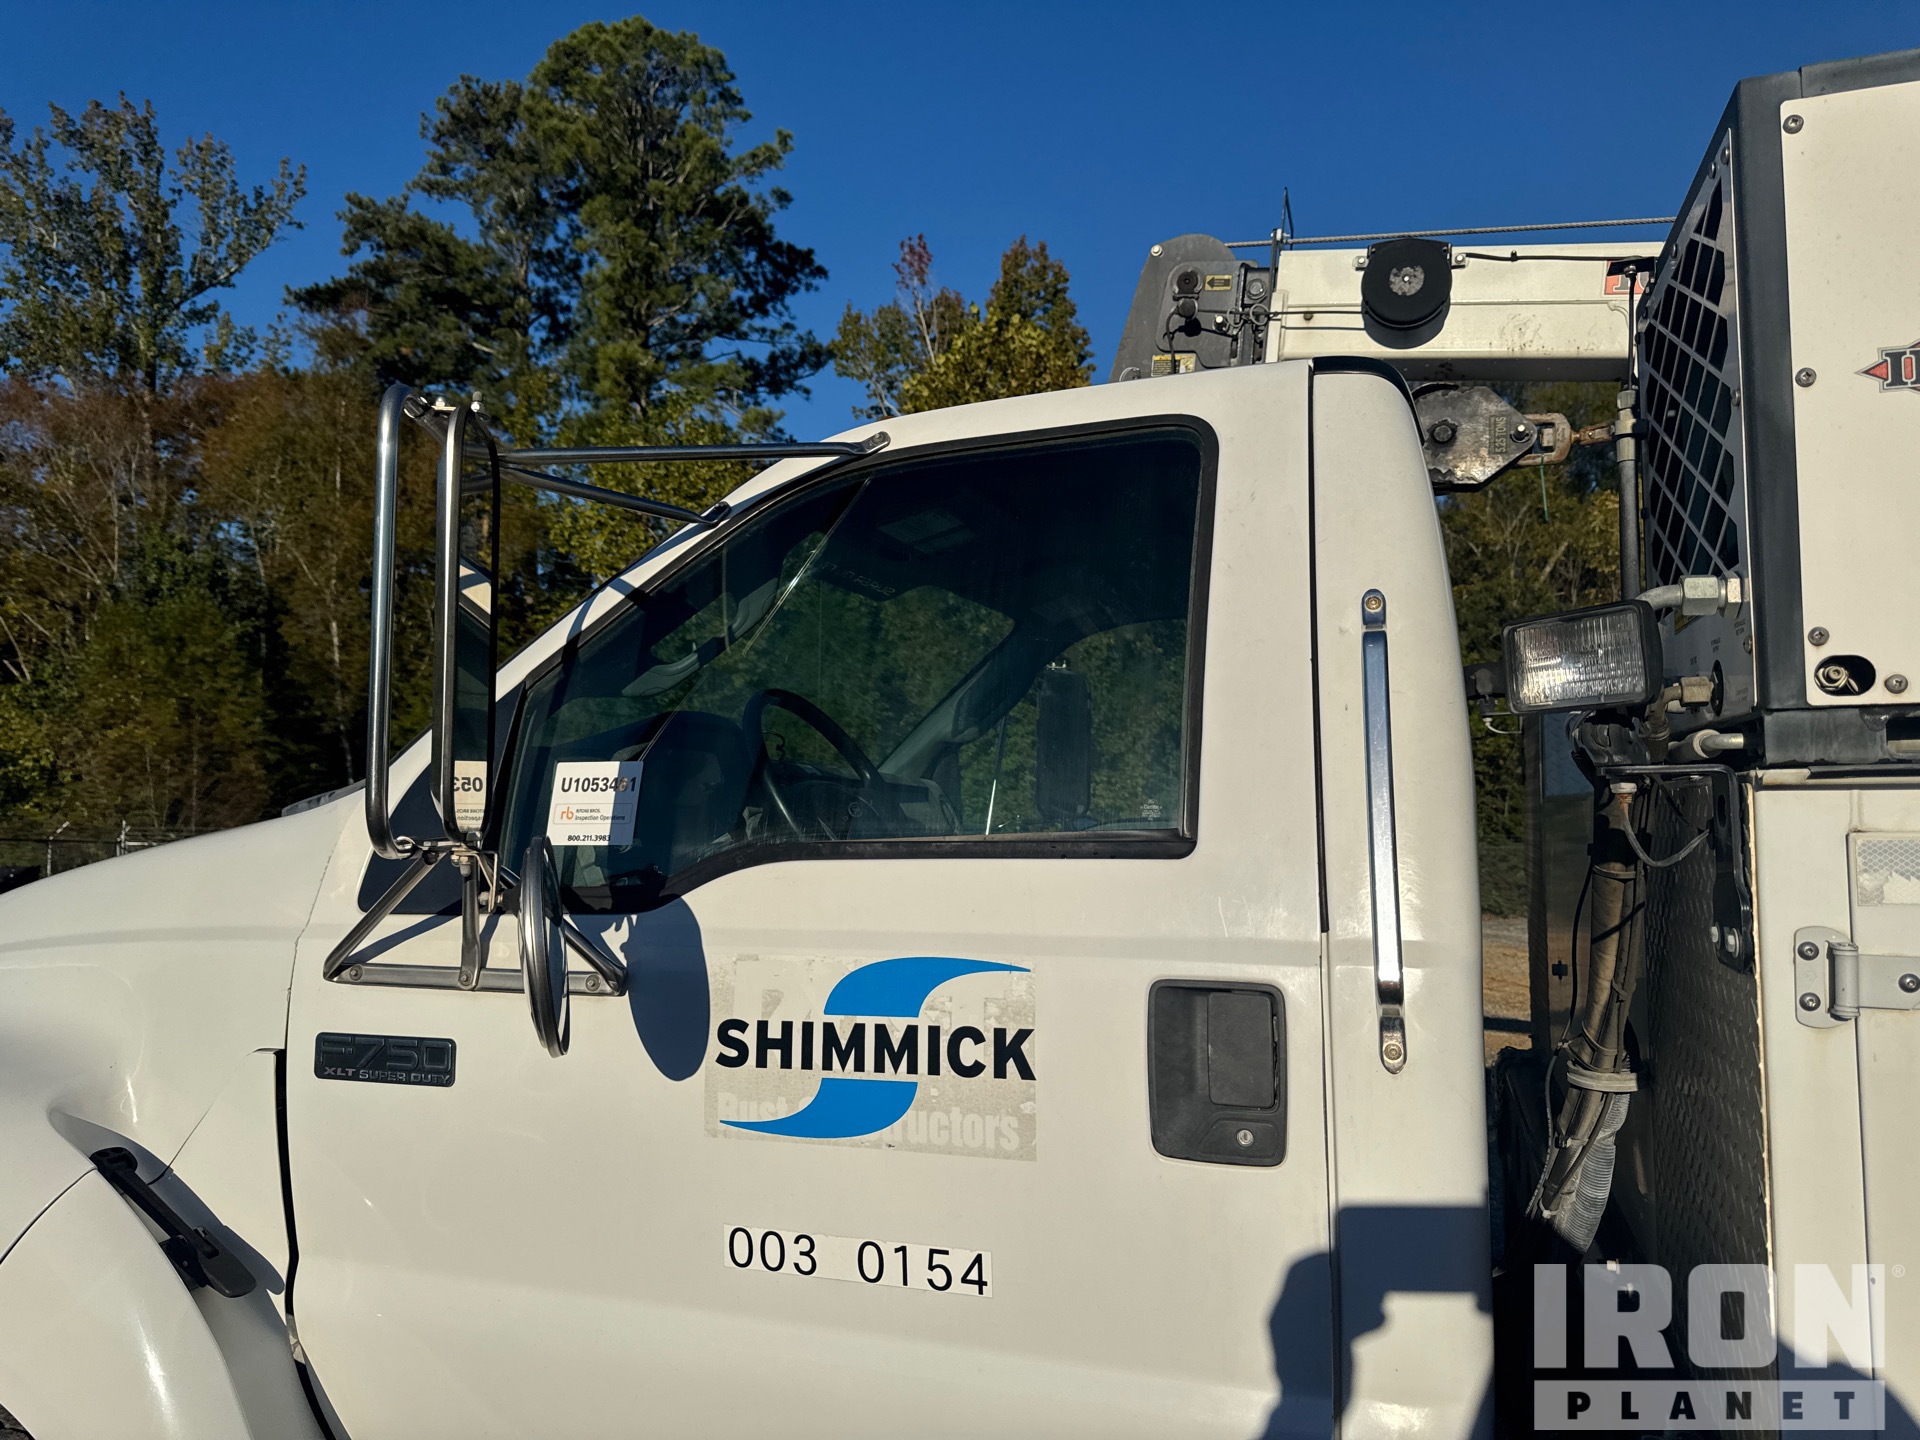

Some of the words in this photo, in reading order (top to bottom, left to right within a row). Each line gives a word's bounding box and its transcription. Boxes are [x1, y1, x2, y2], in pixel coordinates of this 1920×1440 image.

[1495, 416, 1506, 436] TONS
[715, 1018, 1037, 1081] SHIMMICK
[323, 1067, 356, 1076] XLT
[359, 1069, 407, 1082] SUPER
[410, 1072, 451, 1084] DUTY
[729, 1227, 817, 1276] 003
[857, 1241, 989, 1296] 0154
